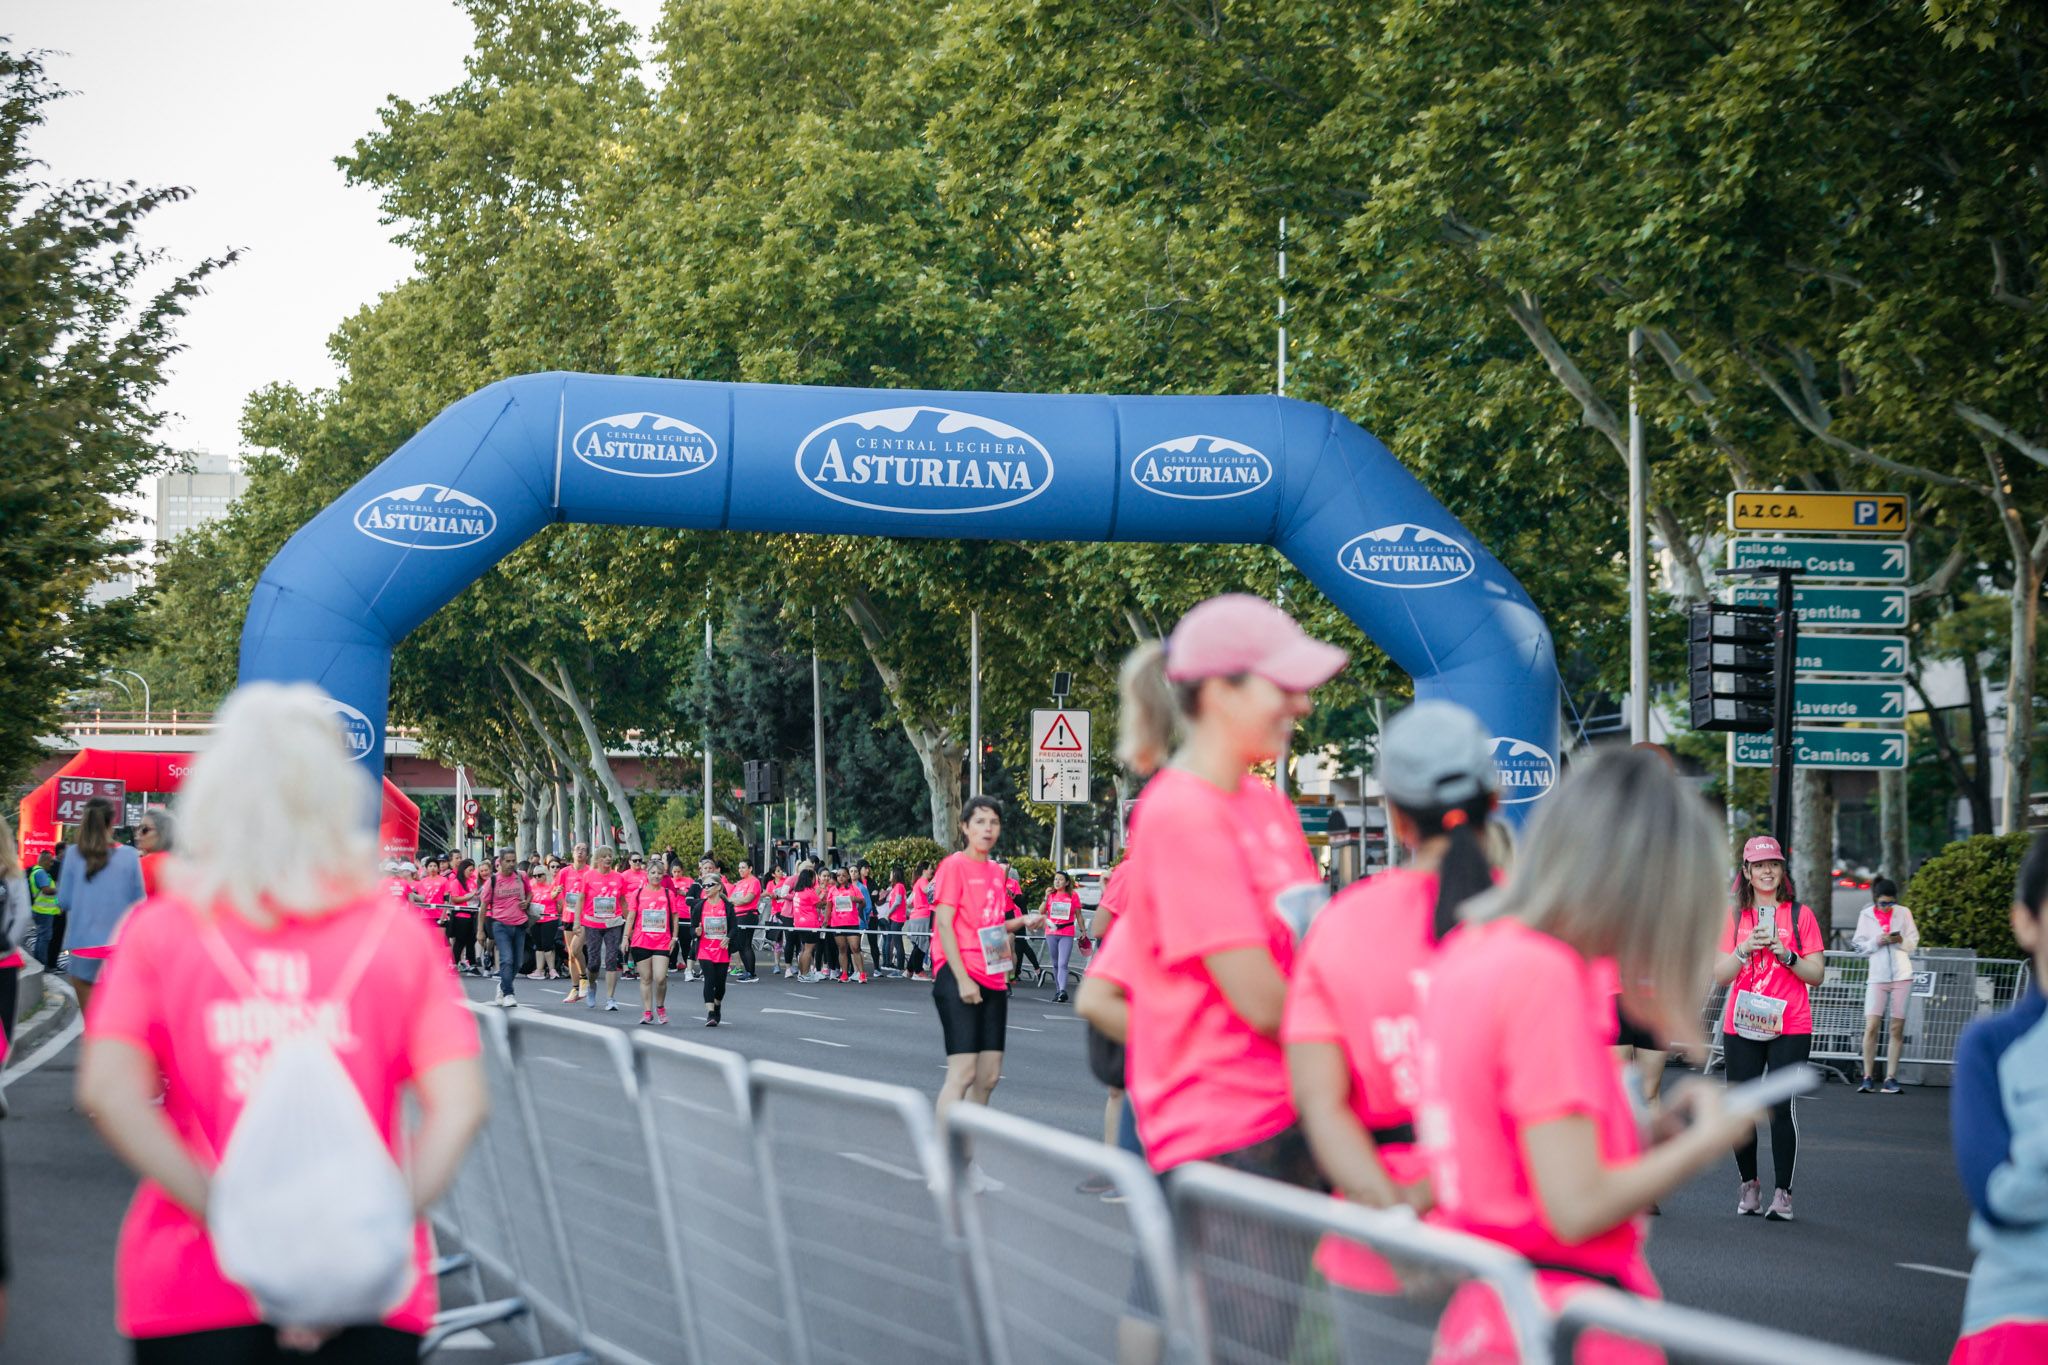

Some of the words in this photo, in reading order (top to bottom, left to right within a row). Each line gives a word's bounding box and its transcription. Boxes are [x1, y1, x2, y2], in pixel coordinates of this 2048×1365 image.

[607, 431, 652, 440] CENTRAL
[656, 434, 702, 443] LECHERA
[583, 431, 706, 463] ASTURIANA
[856, 437, 936, 451] CENTRAL
[945, 441, 1026, 455] LECHERA
[814, 438, 1033, 490] ASTURIANA
[1164, 456, 1208, 464] CENTRAL
[1212, 456, 1257, 464] LECHERA
[1141, 457, 1261, 483] ASTURIANA
[388, 504, 433, 513] CENTRAL
[438, 506, 484, 517] LECHERA
[364, 506, 485, 535] ASTURIANA
[1370, 545, 1415, 553] CENTRAL
[1737, 543, 1768, 554] calle
[1771, 544, 1787, 555] de
[1349, 546, 1467, 572] ASTURIANA
[1806, 557, 1856, 572] Costa
[1794, 700, 1857, 715] laverde
[1798, 746, 1870, 762] Caminos
[60, 781, 94, 796] SUB
